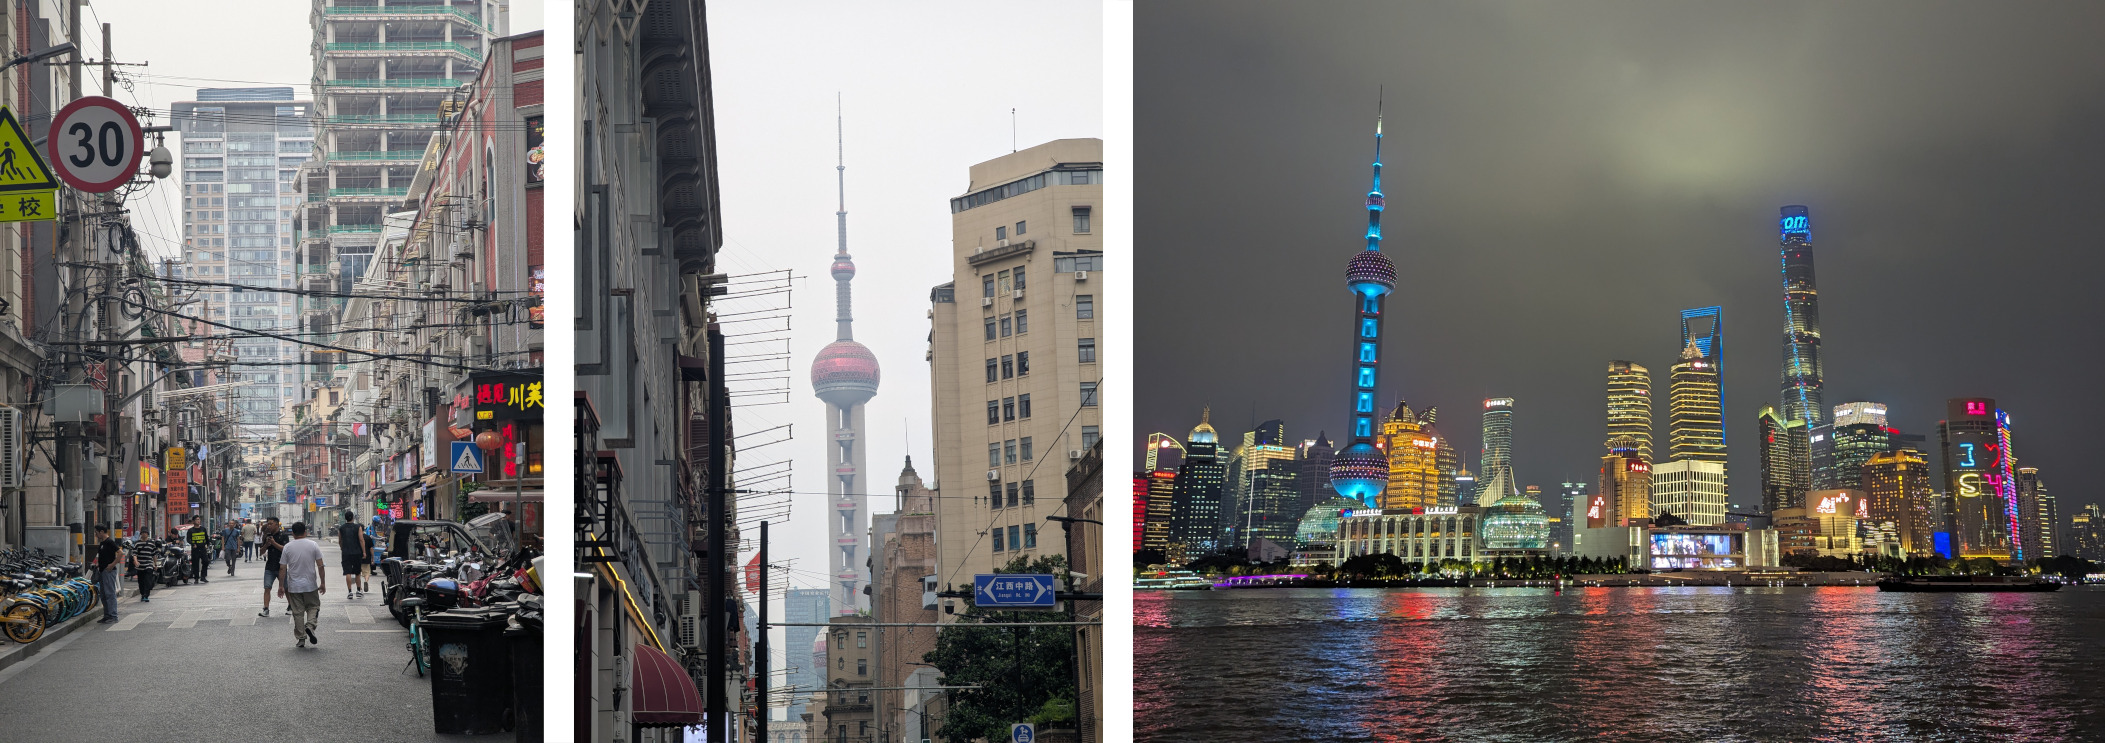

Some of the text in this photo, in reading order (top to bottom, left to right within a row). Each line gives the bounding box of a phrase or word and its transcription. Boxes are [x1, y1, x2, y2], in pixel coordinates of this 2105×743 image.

[69, 121, 124, 168] 30
[0, 196, 42, 217] 校
[996, 582, 1034, 590] 江西中路
